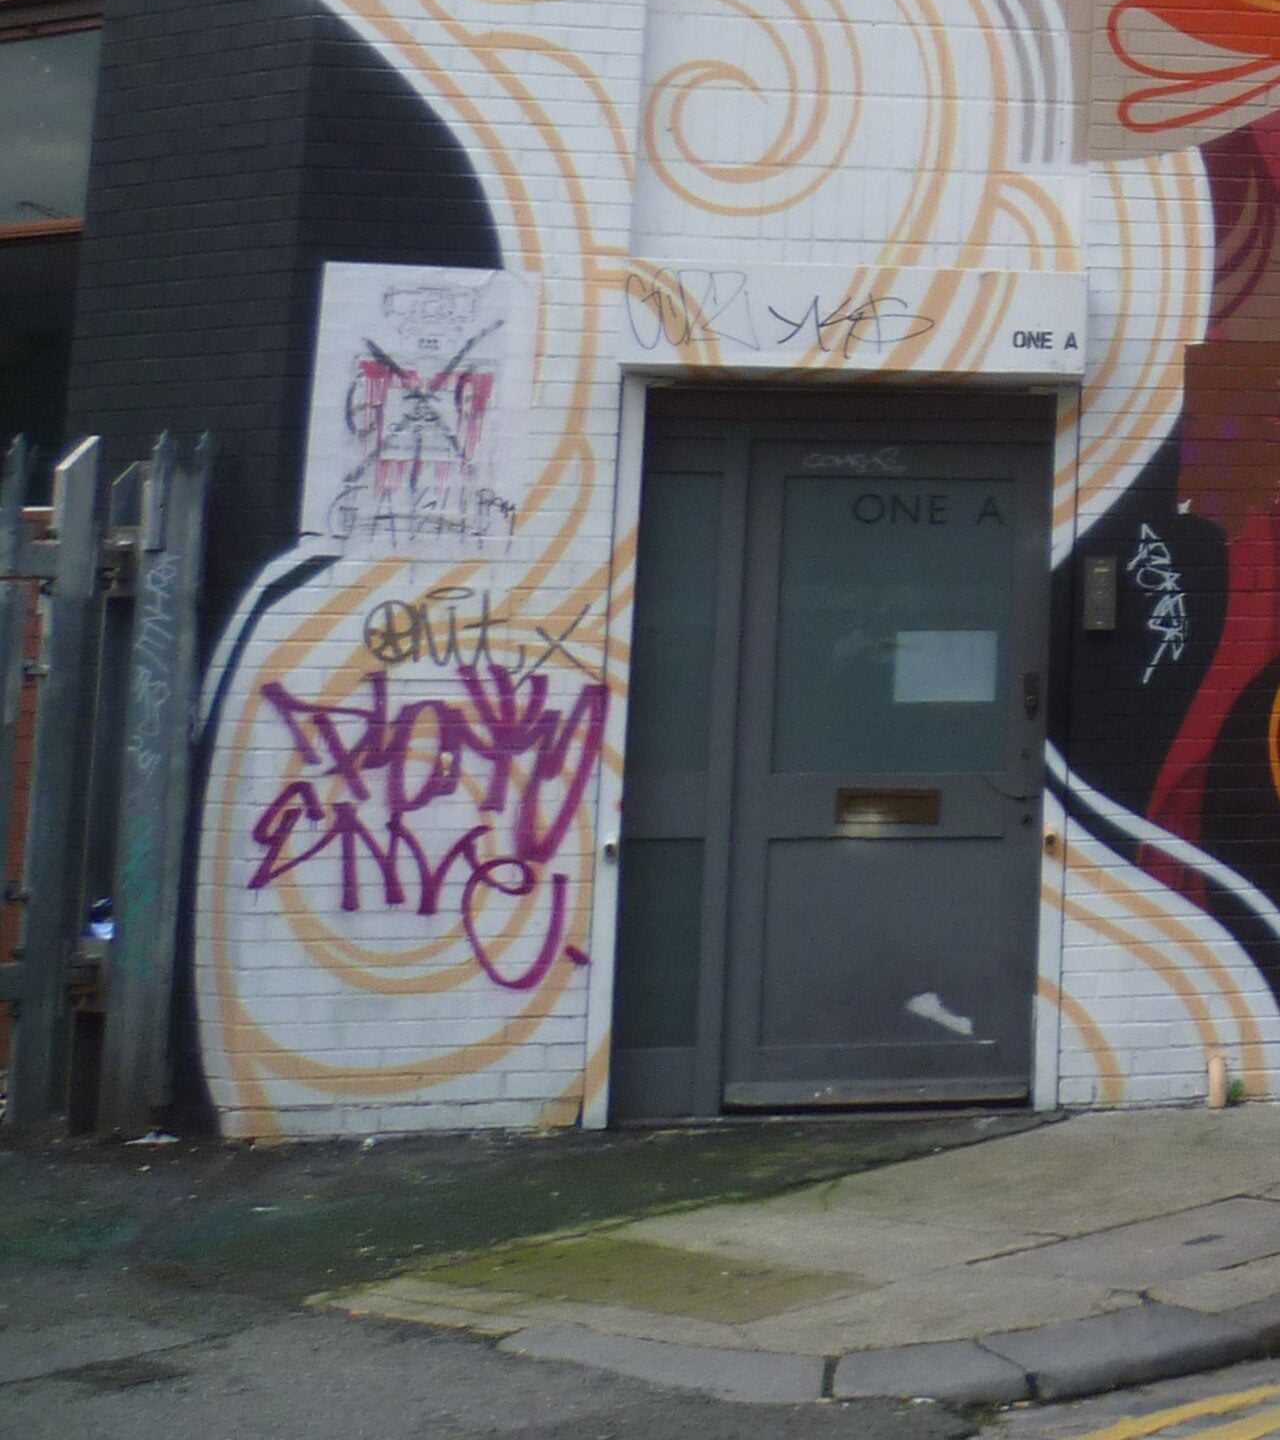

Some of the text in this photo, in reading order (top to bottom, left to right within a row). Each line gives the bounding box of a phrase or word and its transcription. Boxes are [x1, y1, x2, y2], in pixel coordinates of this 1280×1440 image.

[1012, 330, 1079, 351] ONE A
[853, 492, 1004, 526] ONE A
